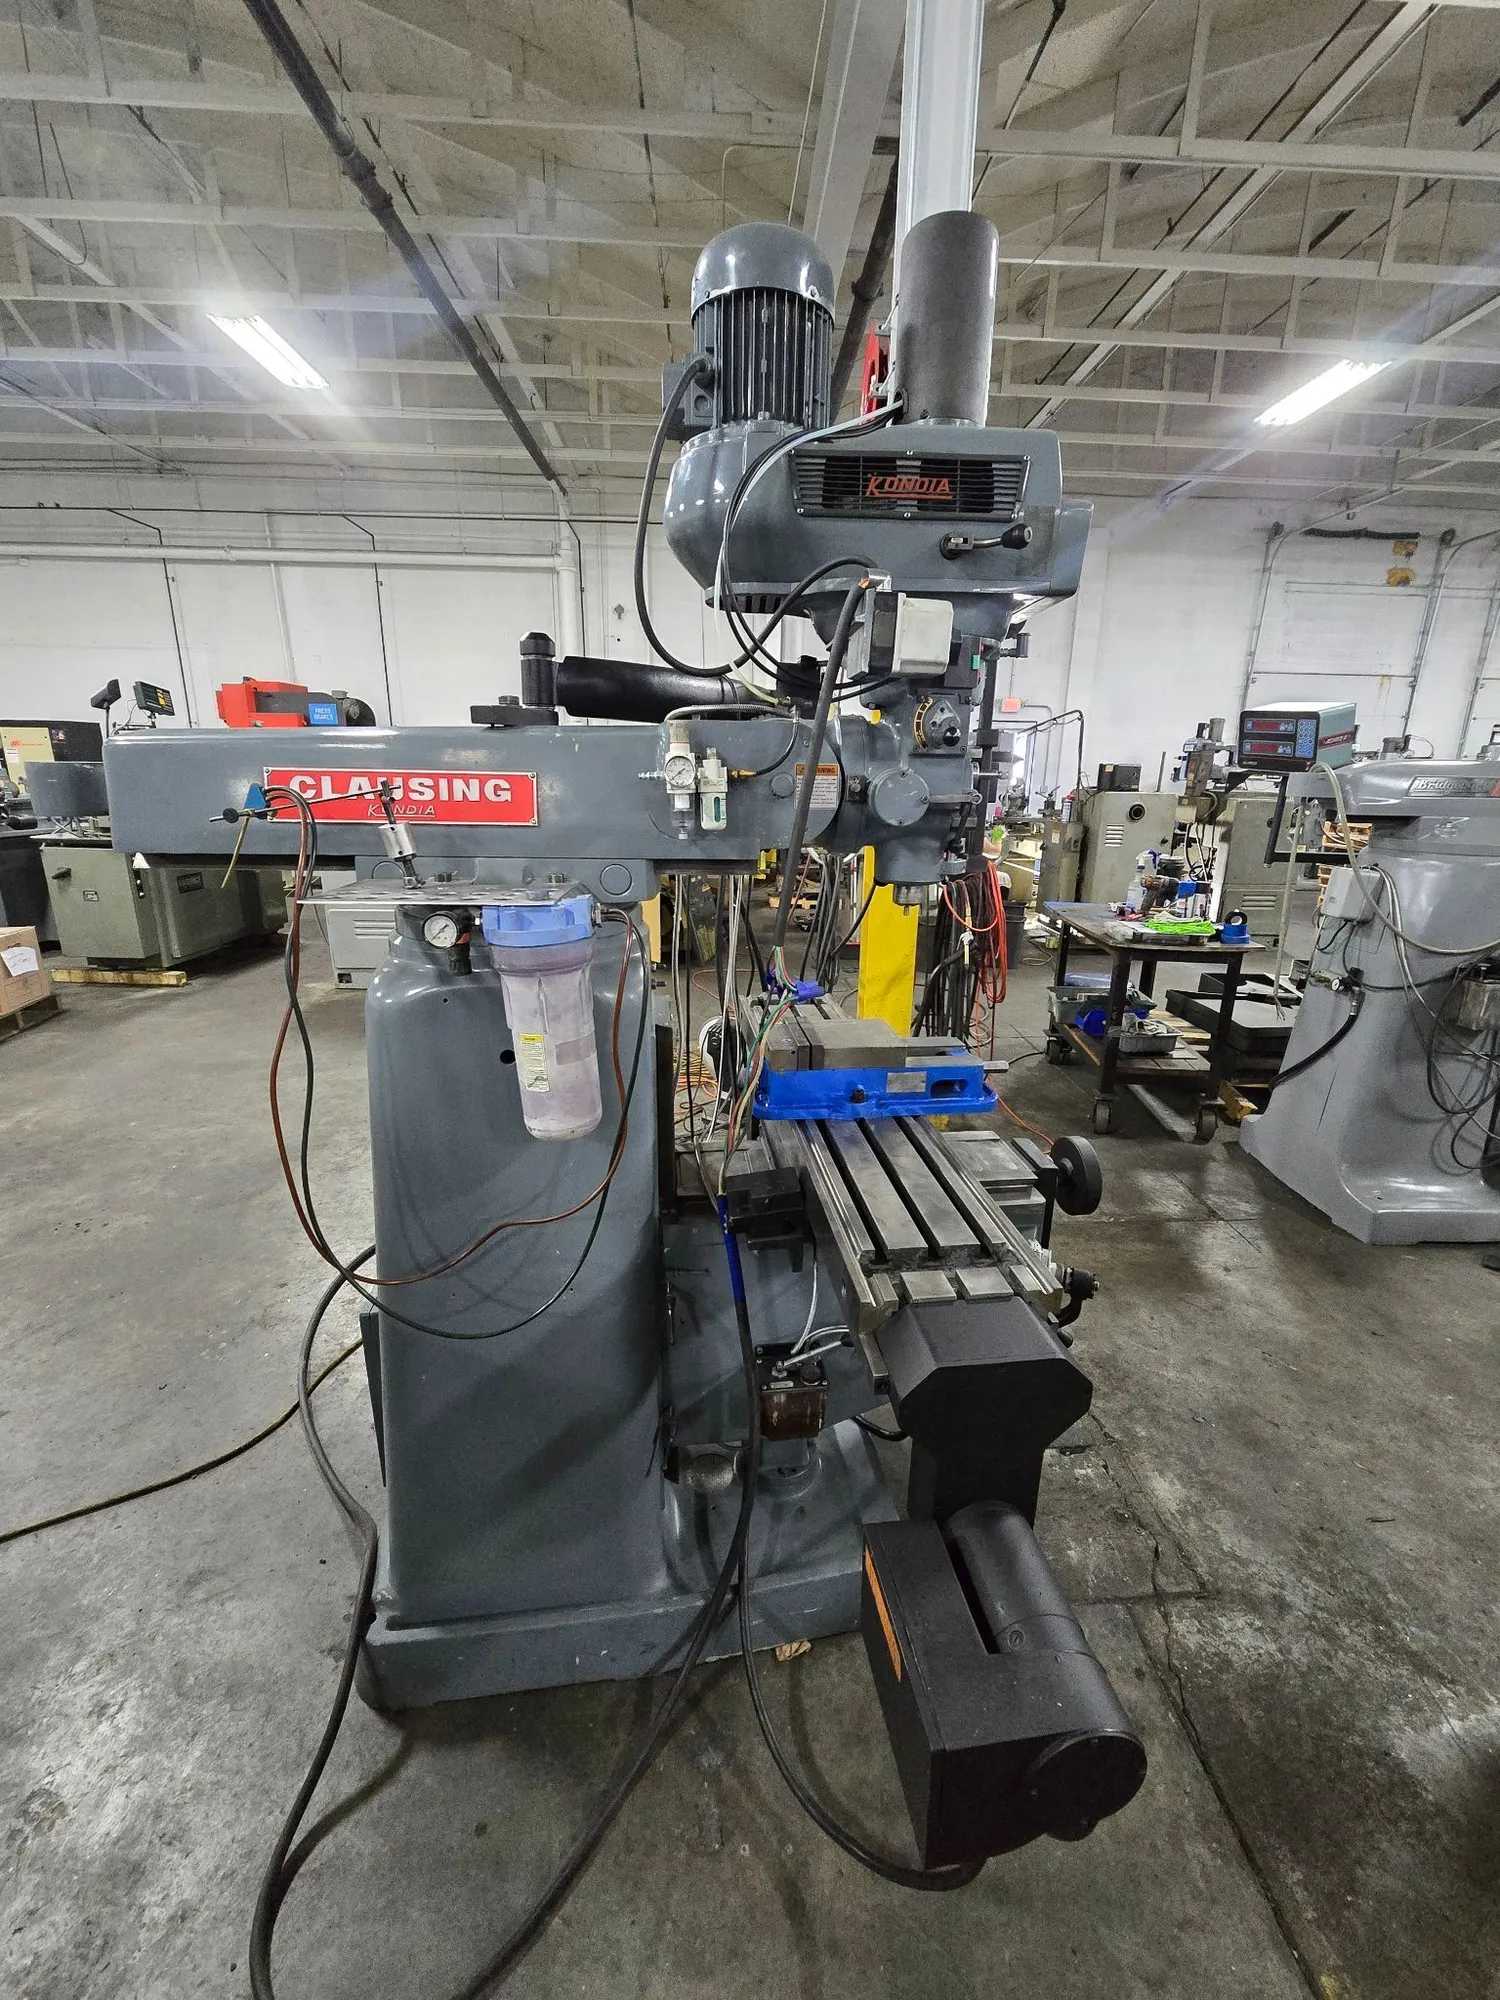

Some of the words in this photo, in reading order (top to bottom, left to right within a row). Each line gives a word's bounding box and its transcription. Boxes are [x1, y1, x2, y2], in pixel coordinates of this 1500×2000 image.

[865, 475, 951, 497] KONDIA
[290, 775, 512, 802] CLAUSING
[368, 804, 435, 817] KNDIA
